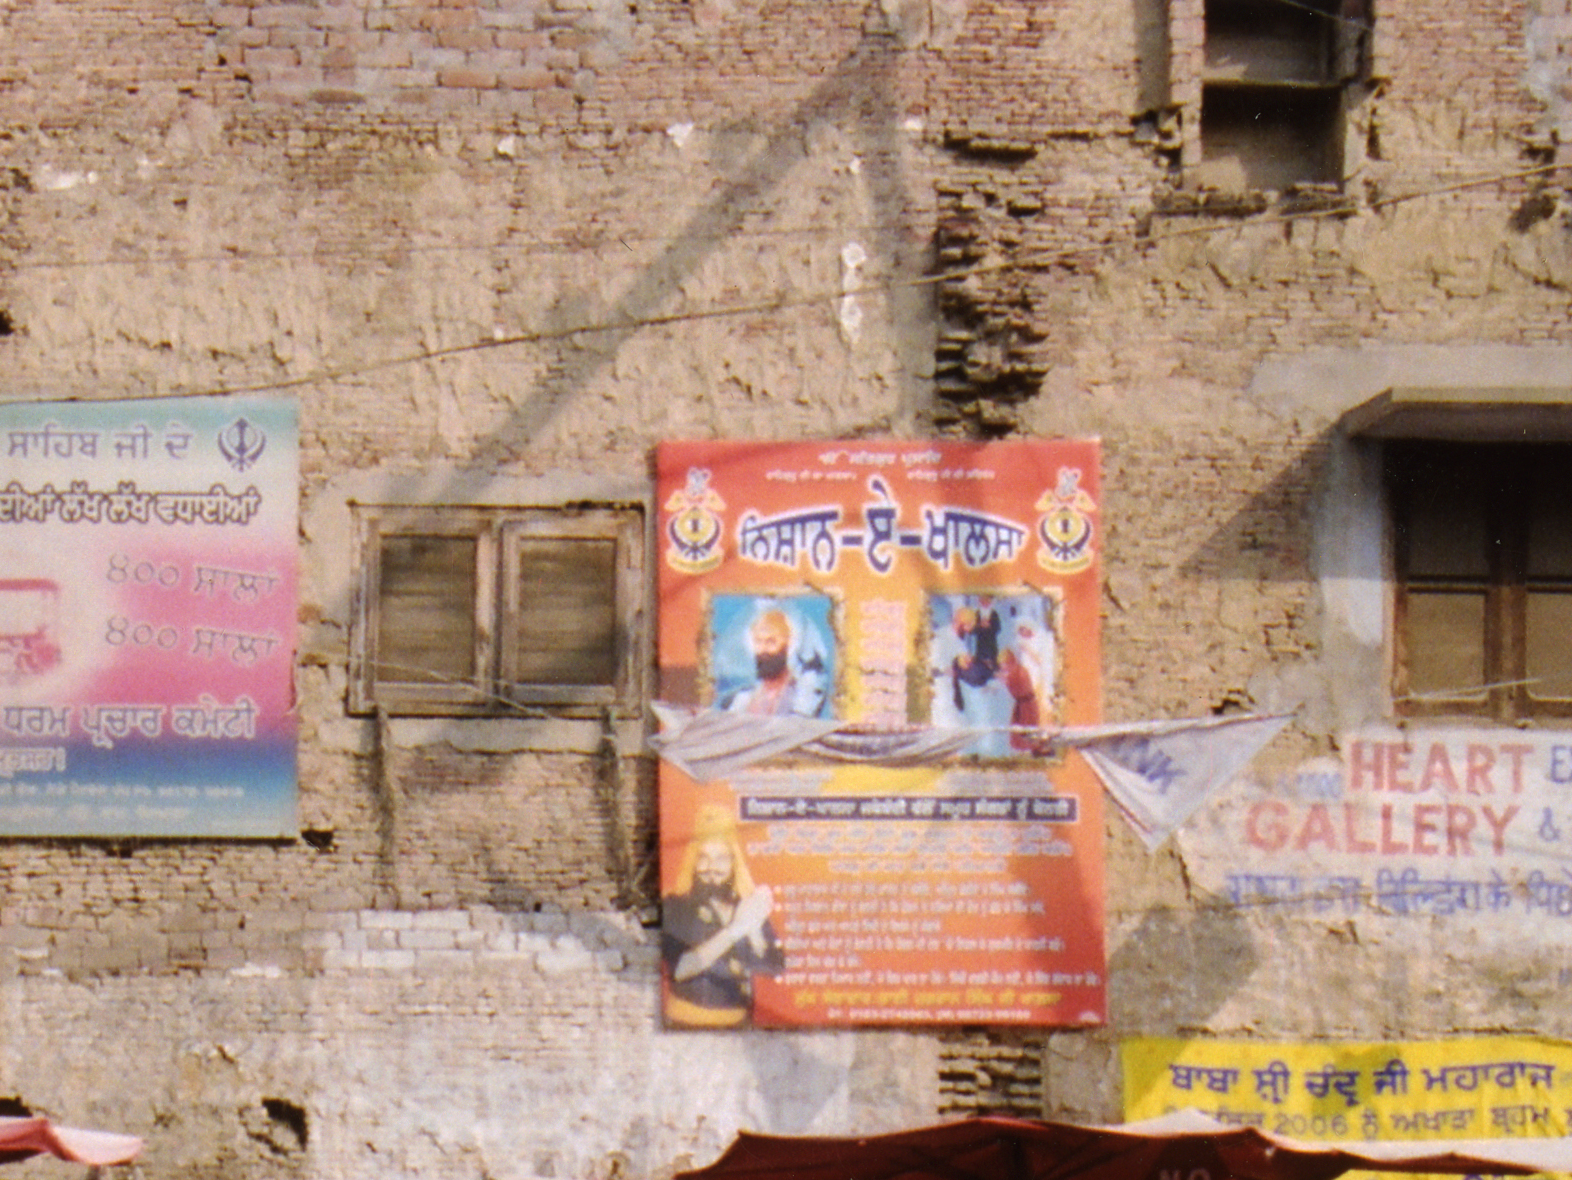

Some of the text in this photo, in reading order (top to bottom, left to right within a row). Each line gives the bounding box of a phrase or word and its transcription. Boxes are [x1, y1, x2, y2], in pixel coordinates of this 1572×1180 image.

[8, 423, 99, 457] ਸਾਹਿਬ
[115, 423, 152, 457] ਜੀ
[165, 422, 192, 459] ਦੇ
[58, 480, 104, 523] ਲੱਖ
[106, 480, 152, 523] ਲੱਖ
[2, 704, 71, 738] ਧਰਮ
[80, 703, 168, 749] ਪ੍ਰਚਾਰ
[172, 693, 260, 739] ਕਮੇਟੀ
[1349, 741, 1534, 793] HEART
[1245, 801, 1561, 856] GALLERY &
[1170, 1064, 1239, 1093] ਬਾਬਾ
[1373, 1058, 1410, 1095] ਜੀ
[1422, 1062, 1557, 1094] ਮਹਾਰਾਜ
[1275, 1113, 1349, 1138] 2006
